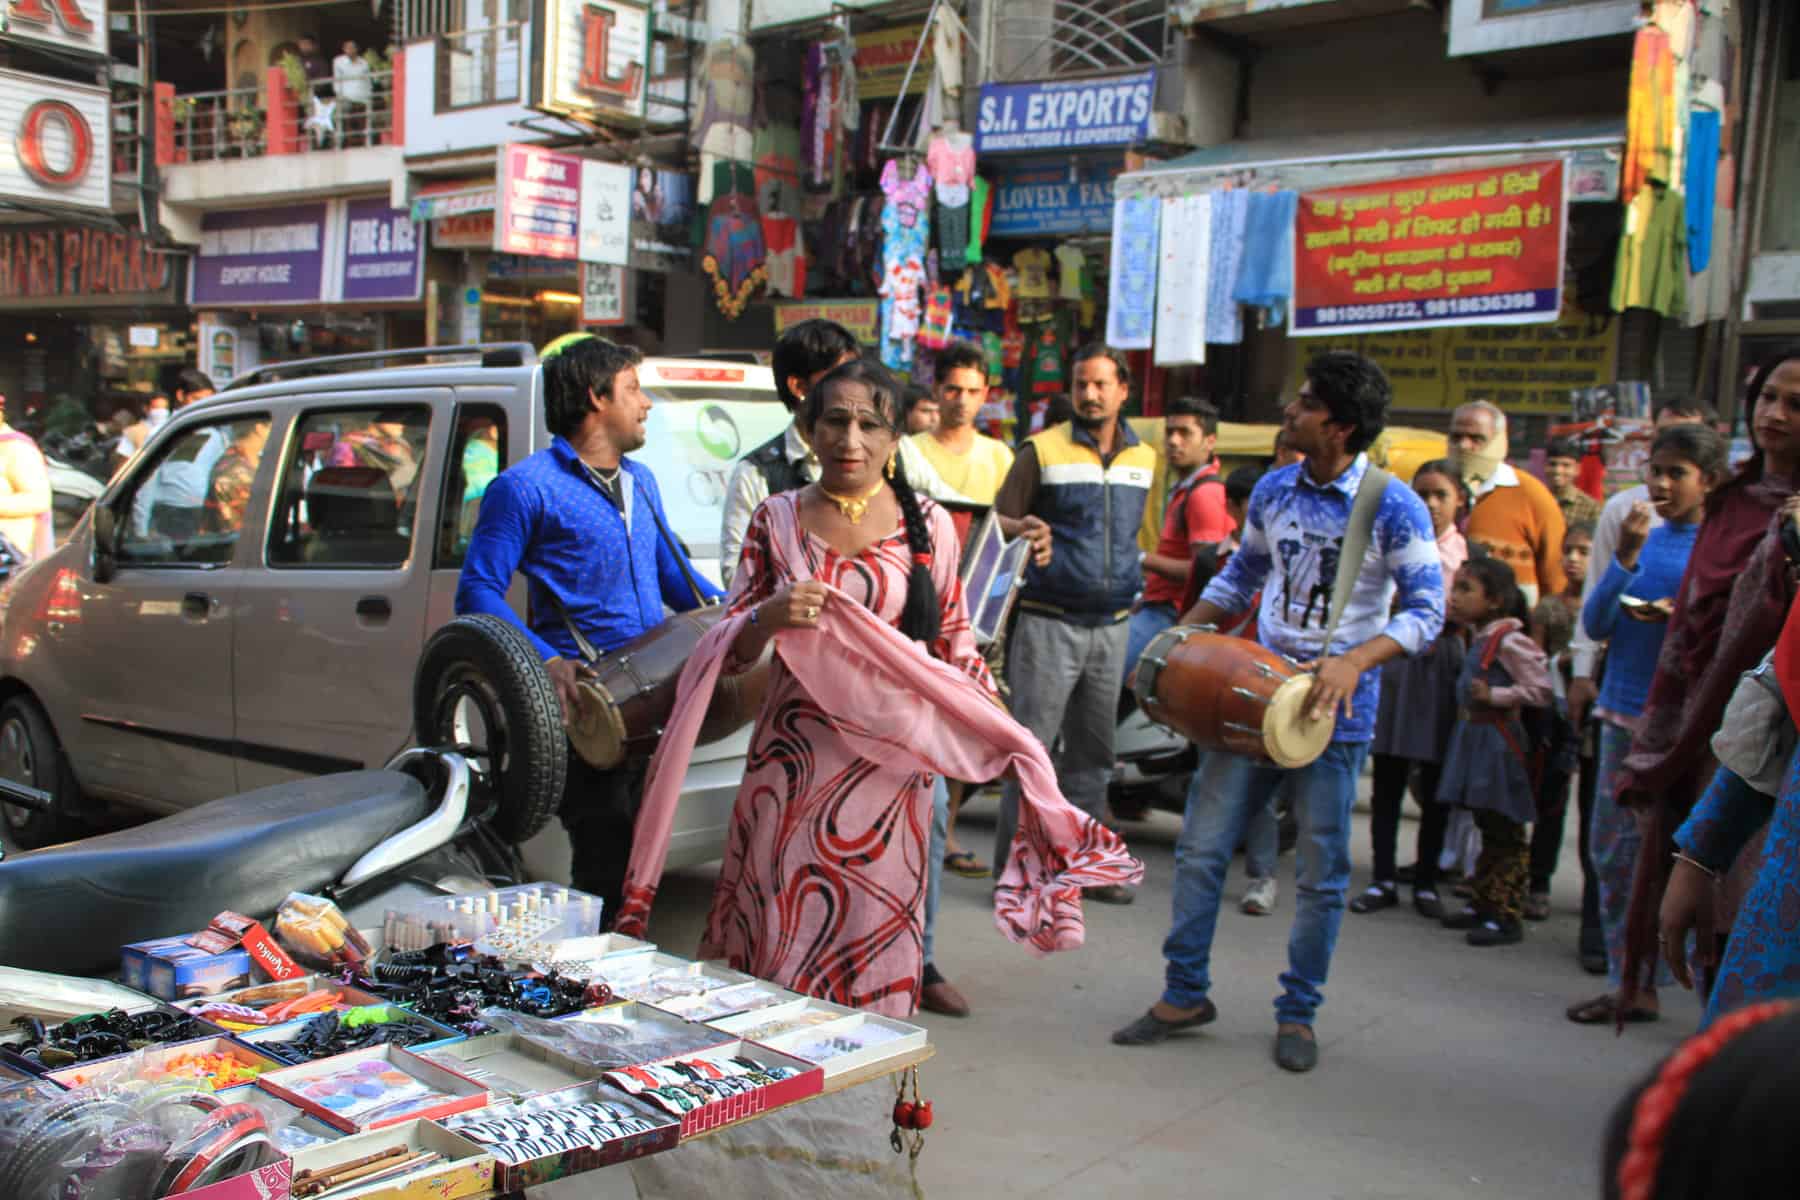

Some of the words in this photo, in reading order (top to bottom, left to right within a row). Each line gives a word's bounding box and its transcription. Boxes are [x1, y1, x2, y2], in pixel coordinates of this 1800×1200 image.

[577, 3, 643, 98] L
[980, 96, 1018, 132] S.I.
[1024, 85, 1149, 130] EXPORTS
[17, 99, 94, 188] O
[999, 184, 1071, 210] LOVELY
[220, 266, 257, 285] EXPORT
[257, 263, 292, 283] HOUSE
